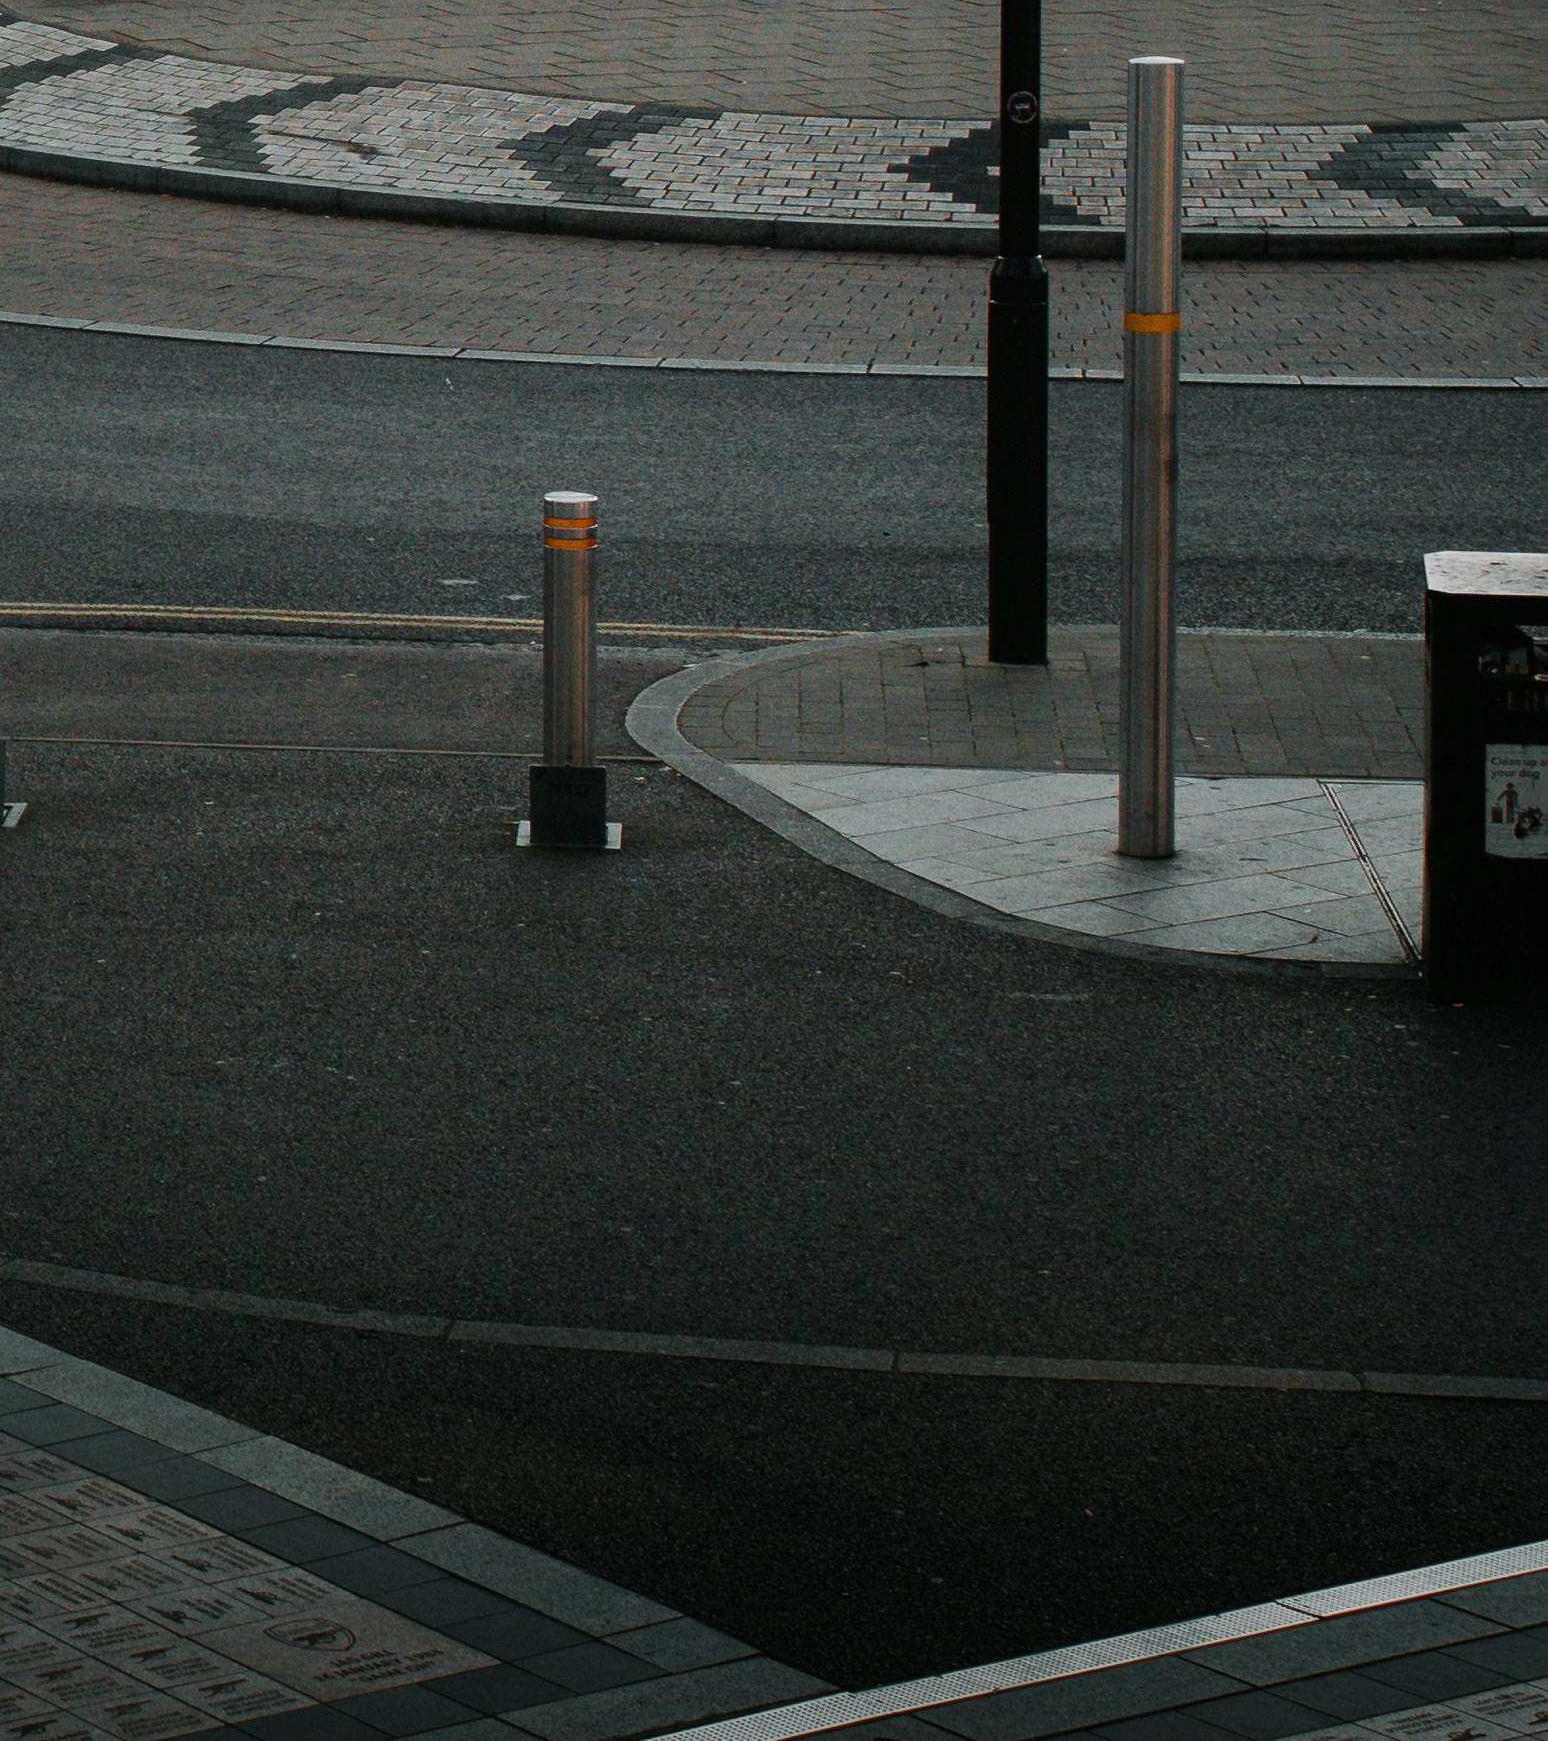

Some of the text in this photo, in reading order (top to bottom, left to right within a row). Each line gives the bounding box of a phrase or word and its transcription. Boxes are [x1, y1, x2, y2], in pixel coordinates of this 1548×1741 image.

[1490, 756, 1521, 767] Clean
[1523, 757, 1537, 769] up
[1491, 767, 1540, 781] your dog
